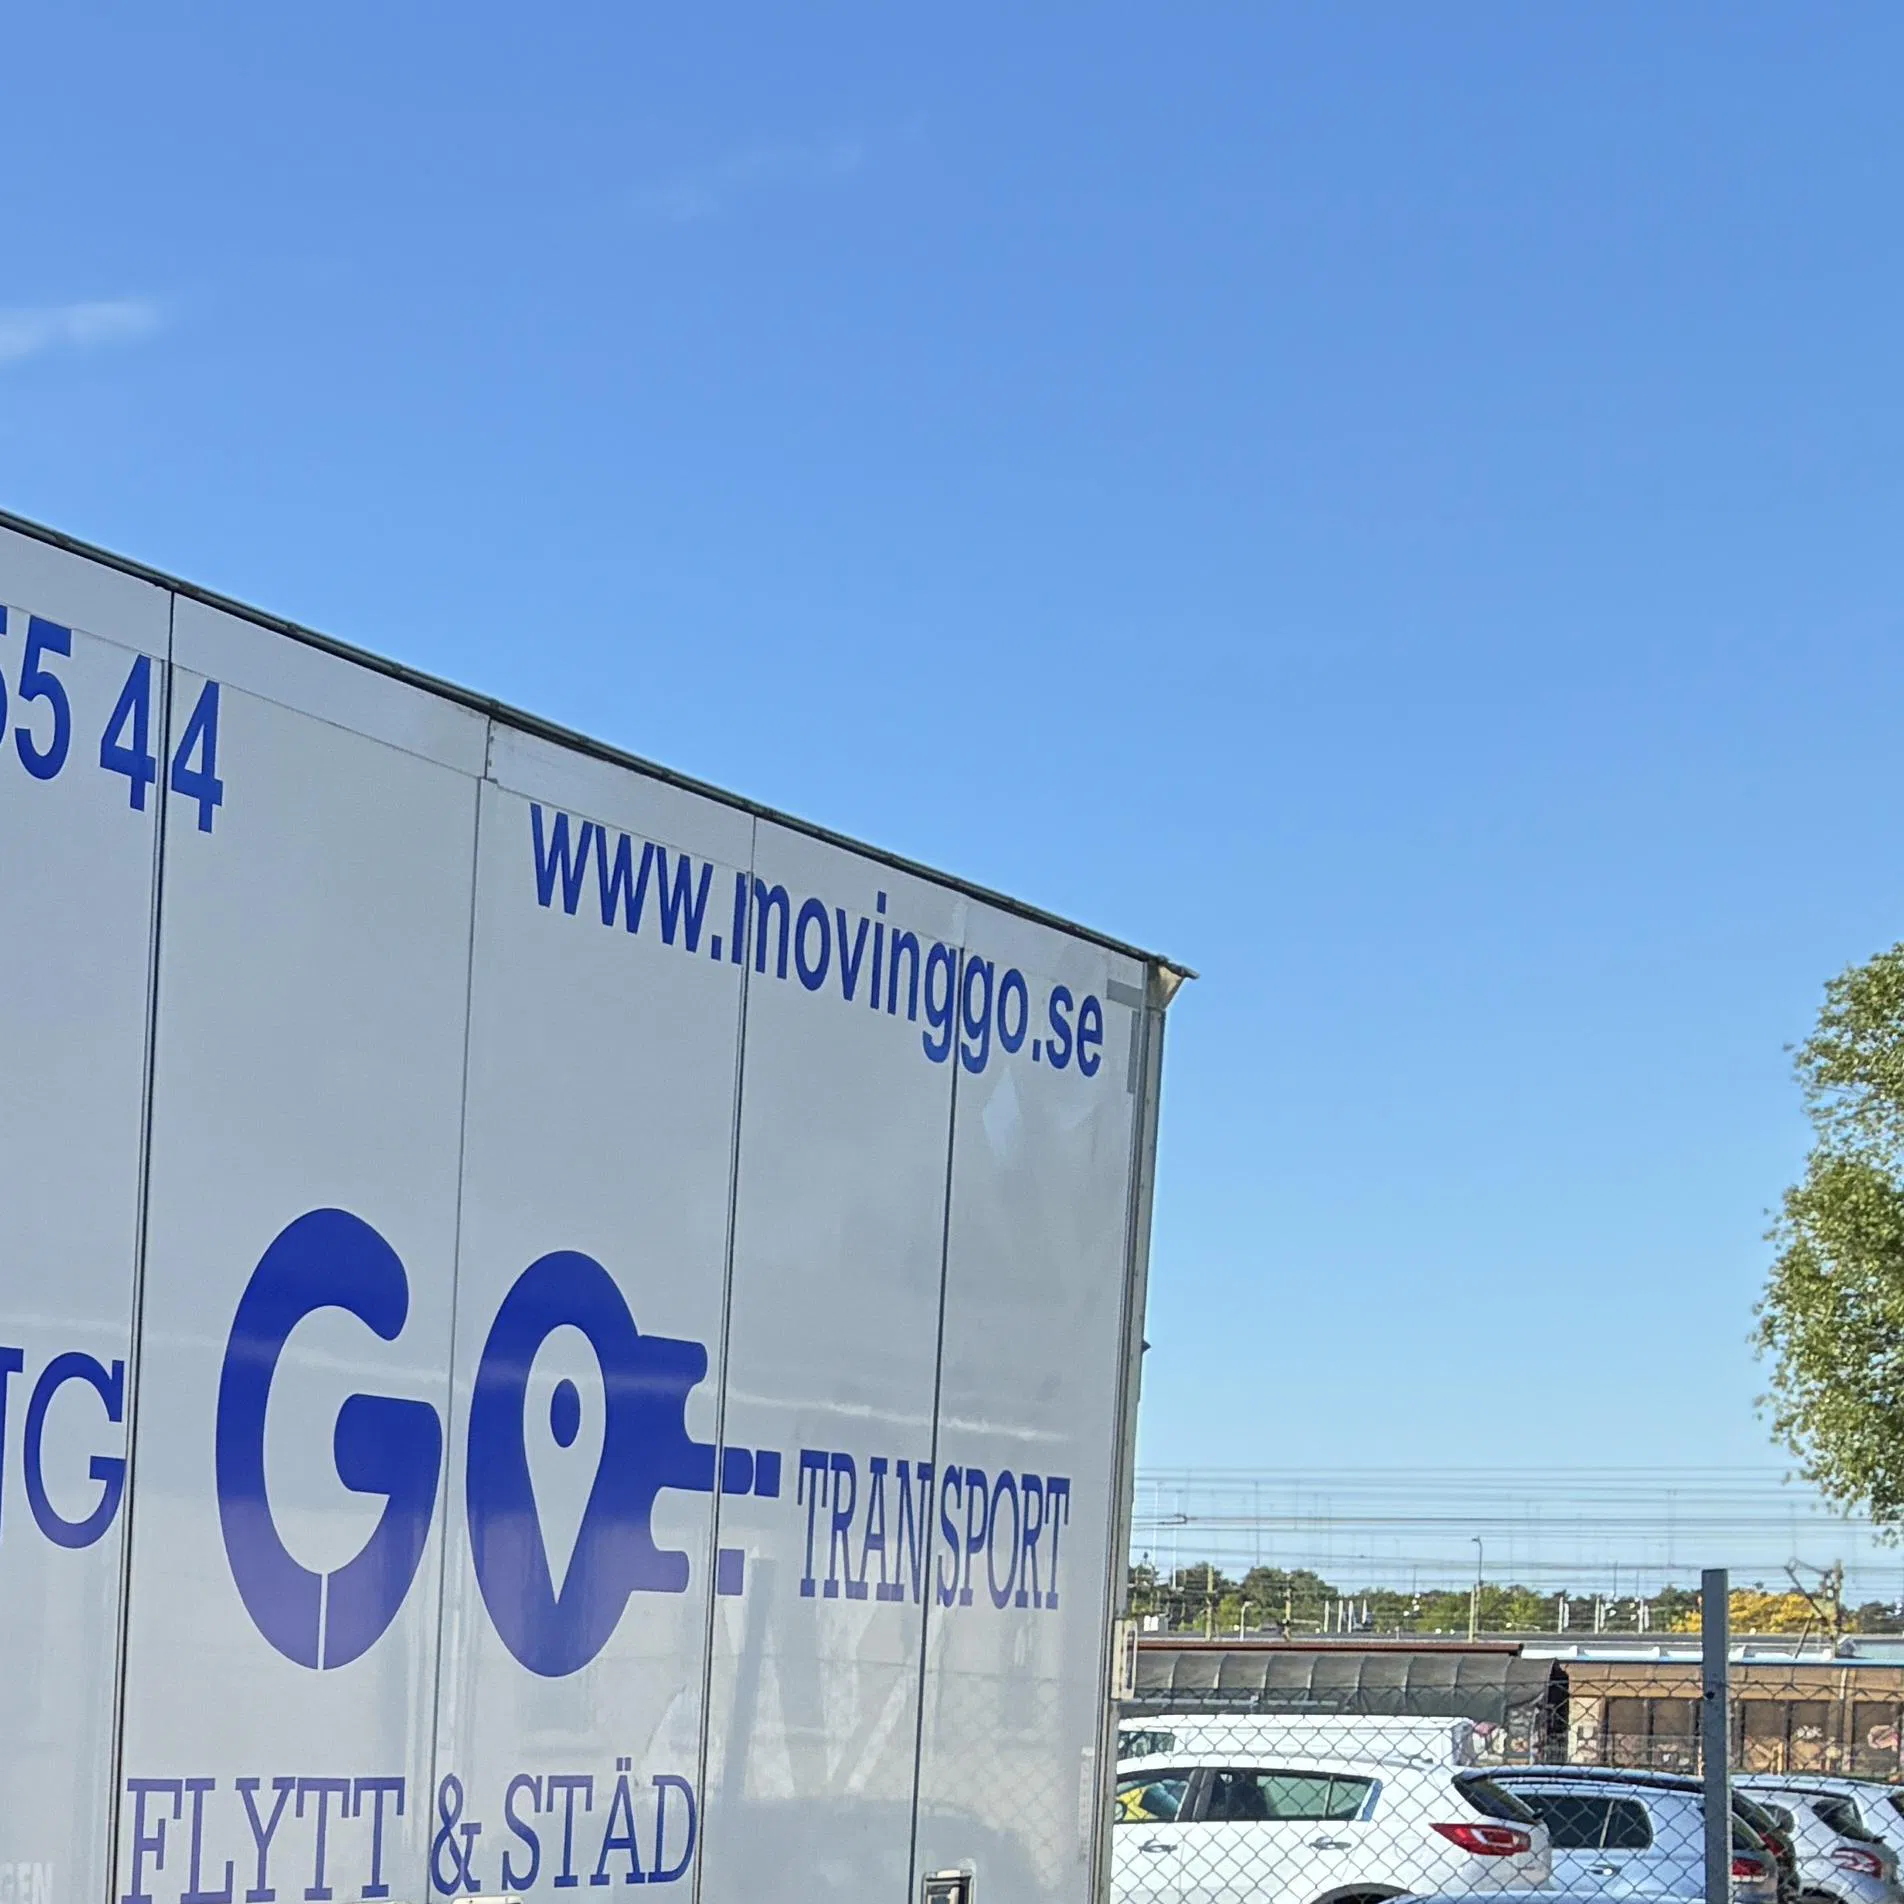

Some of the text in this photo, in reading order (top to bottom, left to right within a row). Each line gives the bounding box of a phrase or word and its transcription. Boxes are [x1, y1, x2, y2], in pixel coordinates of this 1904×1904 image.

[99, 654, 224, 834] 44
[529, 802, 1103, 1077] www.movinggo.se
[215, 1207, 708, 1677] GO
[796, 1447, 1072, 1610] TRANSPORT
[429, 1772, 482, 1897] &
[500, 1756, 698, 1892] STÄD
